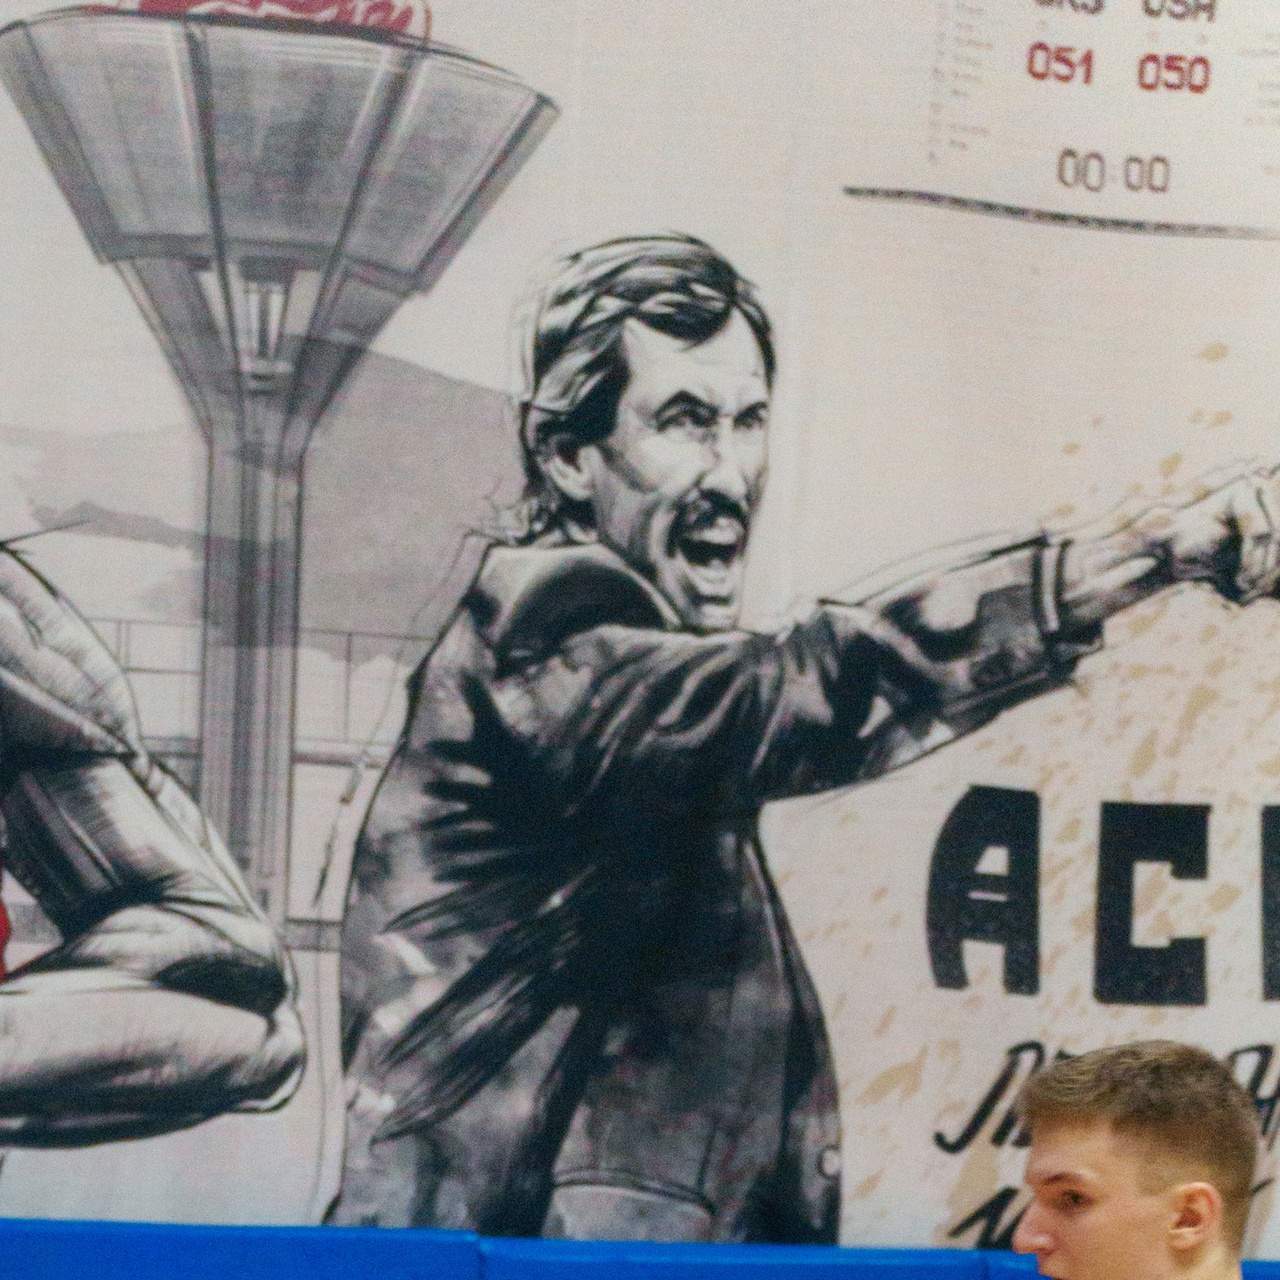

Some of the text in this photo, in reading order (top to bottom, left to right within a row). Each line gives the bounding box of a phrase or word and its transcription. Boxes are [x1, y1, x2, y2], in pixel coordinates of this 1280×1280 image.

[1026, 41, 1211, 94] 051 050
[925, 784, 1280, 1006] АС
